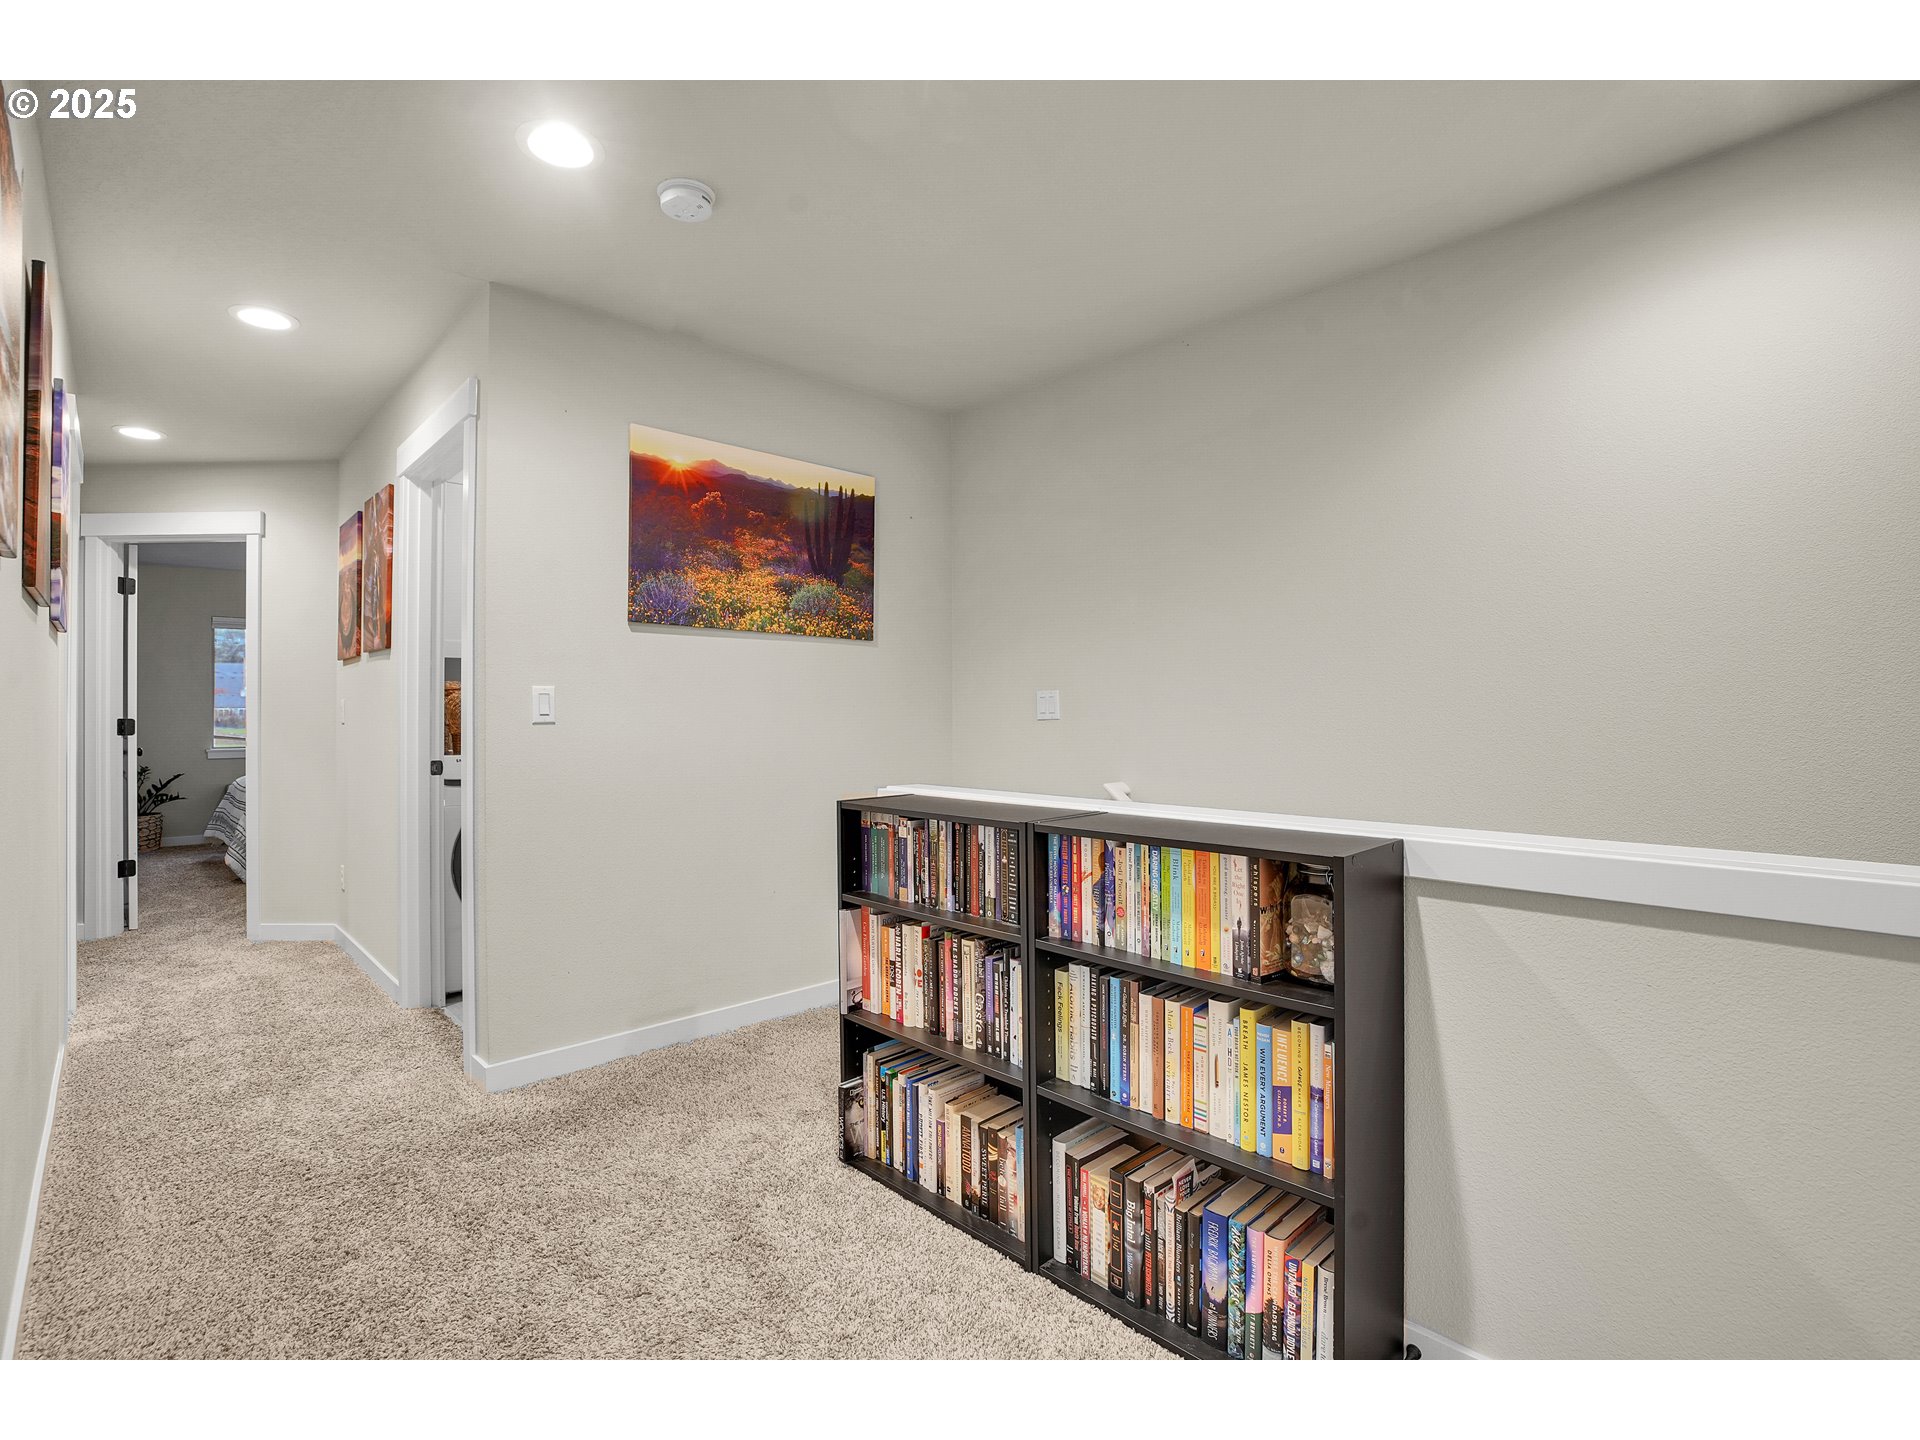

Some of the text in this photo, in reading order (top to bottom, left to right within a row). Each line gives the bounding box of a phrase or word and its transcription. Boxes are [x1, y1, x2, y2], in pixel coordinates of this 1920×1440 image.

[975, 993, 984, 1033] Caste
[1277, 1033, 1287, 1083] INFLUENCE
[962, 1126, 971, 1173] ANNA TODD
[1126, 1199, 1135, 1217] Big
[1127, 1220, 1136, 1243] Intel
[1208, 1221, 1219, 1340] FREDRIK BACKMAN WINNERS
[1230, 1226, 1240, 1304] ASK AGAIN, YES
[1287, 1262, 1297, 1360] UNTAMED GLENNON DOYLE
